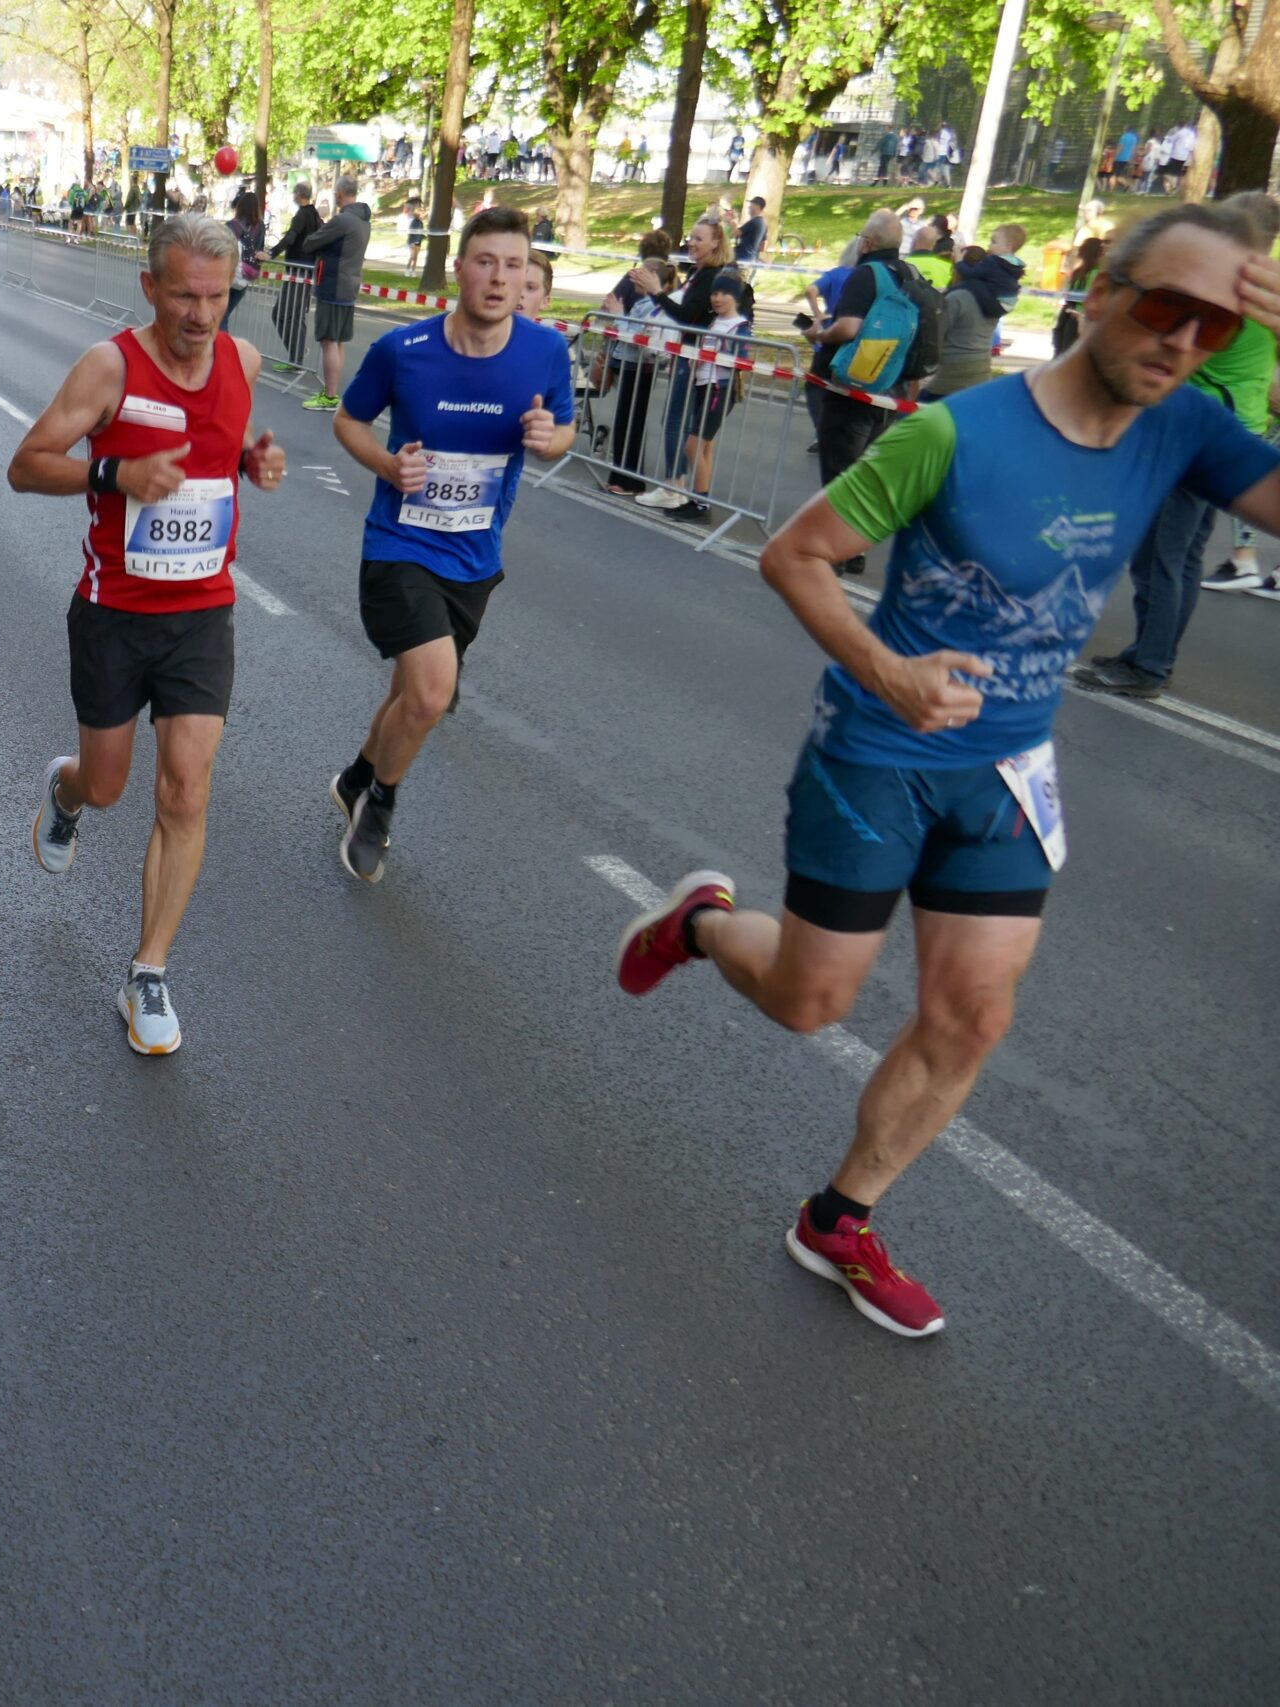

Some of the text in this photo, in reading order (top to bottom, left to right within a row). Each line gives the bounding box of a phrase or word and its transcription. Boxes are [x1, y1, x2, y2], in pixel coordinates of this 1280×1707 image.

[437, 400, 504, 415] #teamKPMG
[425, 482, 480, 502] 8853
[170, 508, 197, 516] Harald
[458, 514, 485, 527] AG
[149, 519, 212, 542] 8982
[192, 557, 219, 573] AG
